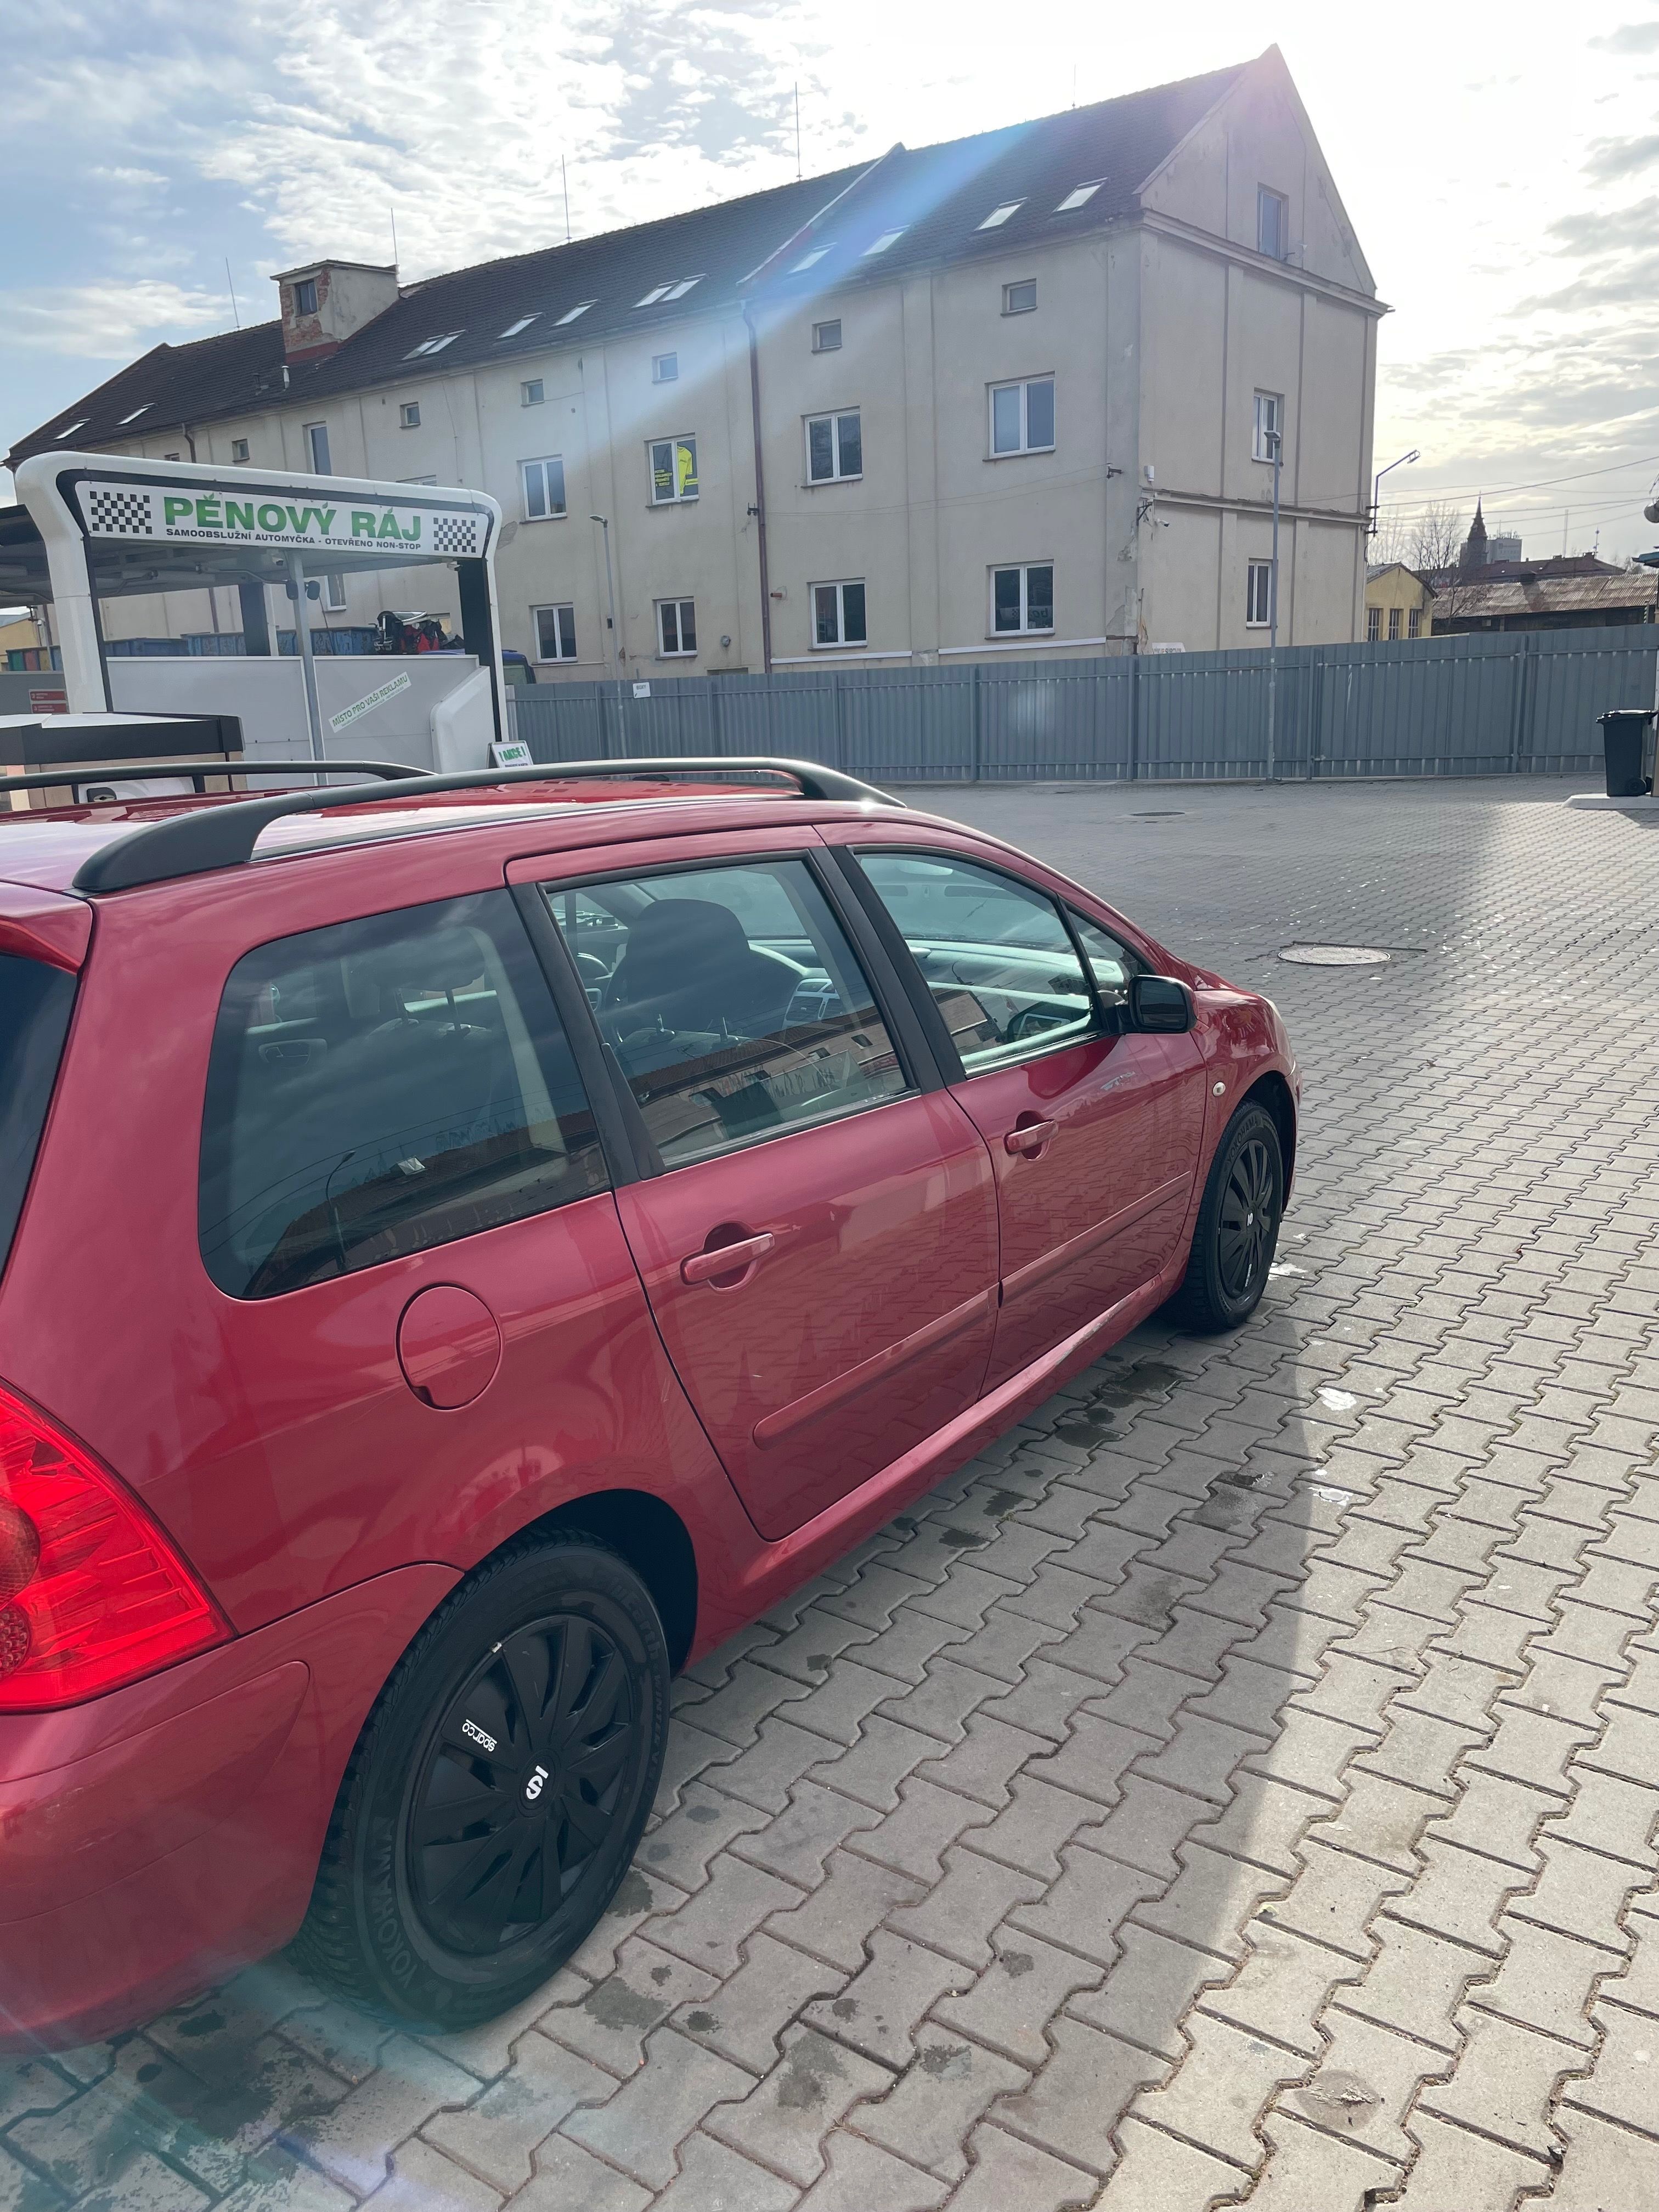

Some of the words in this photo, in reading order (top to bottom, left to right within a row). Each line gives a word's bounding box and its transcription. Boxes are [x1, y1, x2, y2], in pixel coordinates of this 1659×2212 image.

[164, 493, 337, 535] PĚNOVÝ
[351, 507, 421, 541] RÁJ
[166, 528, 251, 540] SAMOOBSLUŽNÍ
[255, 534, 315, 543] AUTOMYČKA
[325, 538, 373, 547] OTEVŘENO
[376, 541, 421, 549] NON-STOP
[332, 710, 352, 726] MÍSTO
[352, 702, 365, 714] PRO
[365, 693, 380, 706] VAŠI
[379, 675, 408, 697] REKLAMU
[1227, 1114, 1259, 1164] YOKOHAMA
[462, 1719, 496, 1752] sparco
[370, 1819, 418, 1989] YOKOHAMA
